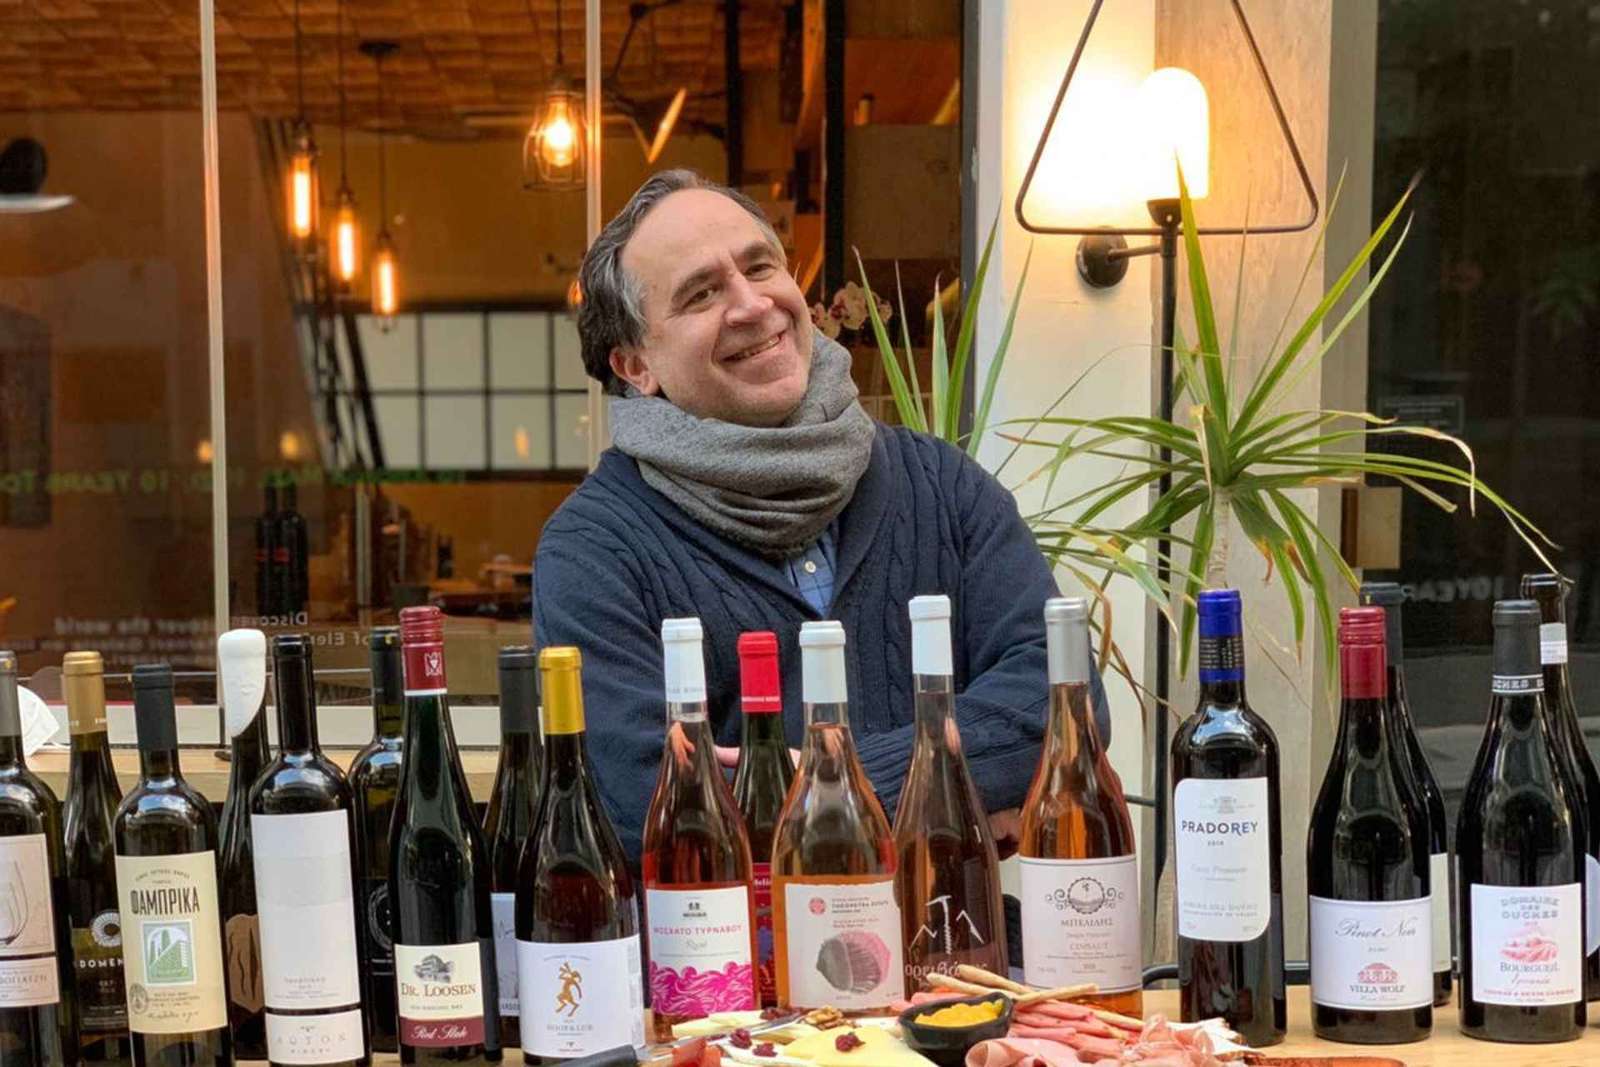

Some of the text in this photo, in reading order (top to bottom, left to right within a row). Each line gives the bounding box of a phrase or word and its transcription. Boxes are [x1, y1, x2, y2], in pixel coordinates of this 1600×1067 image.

[1181, 820, 1258, 836] PRADOREY
[130, 885, 200, 916] ΦΑΜΠΡΙΚΑ
[424, 982, 477, 998] LOOSEN
[1350, 984, 1406, 994] VILLA WOLF
